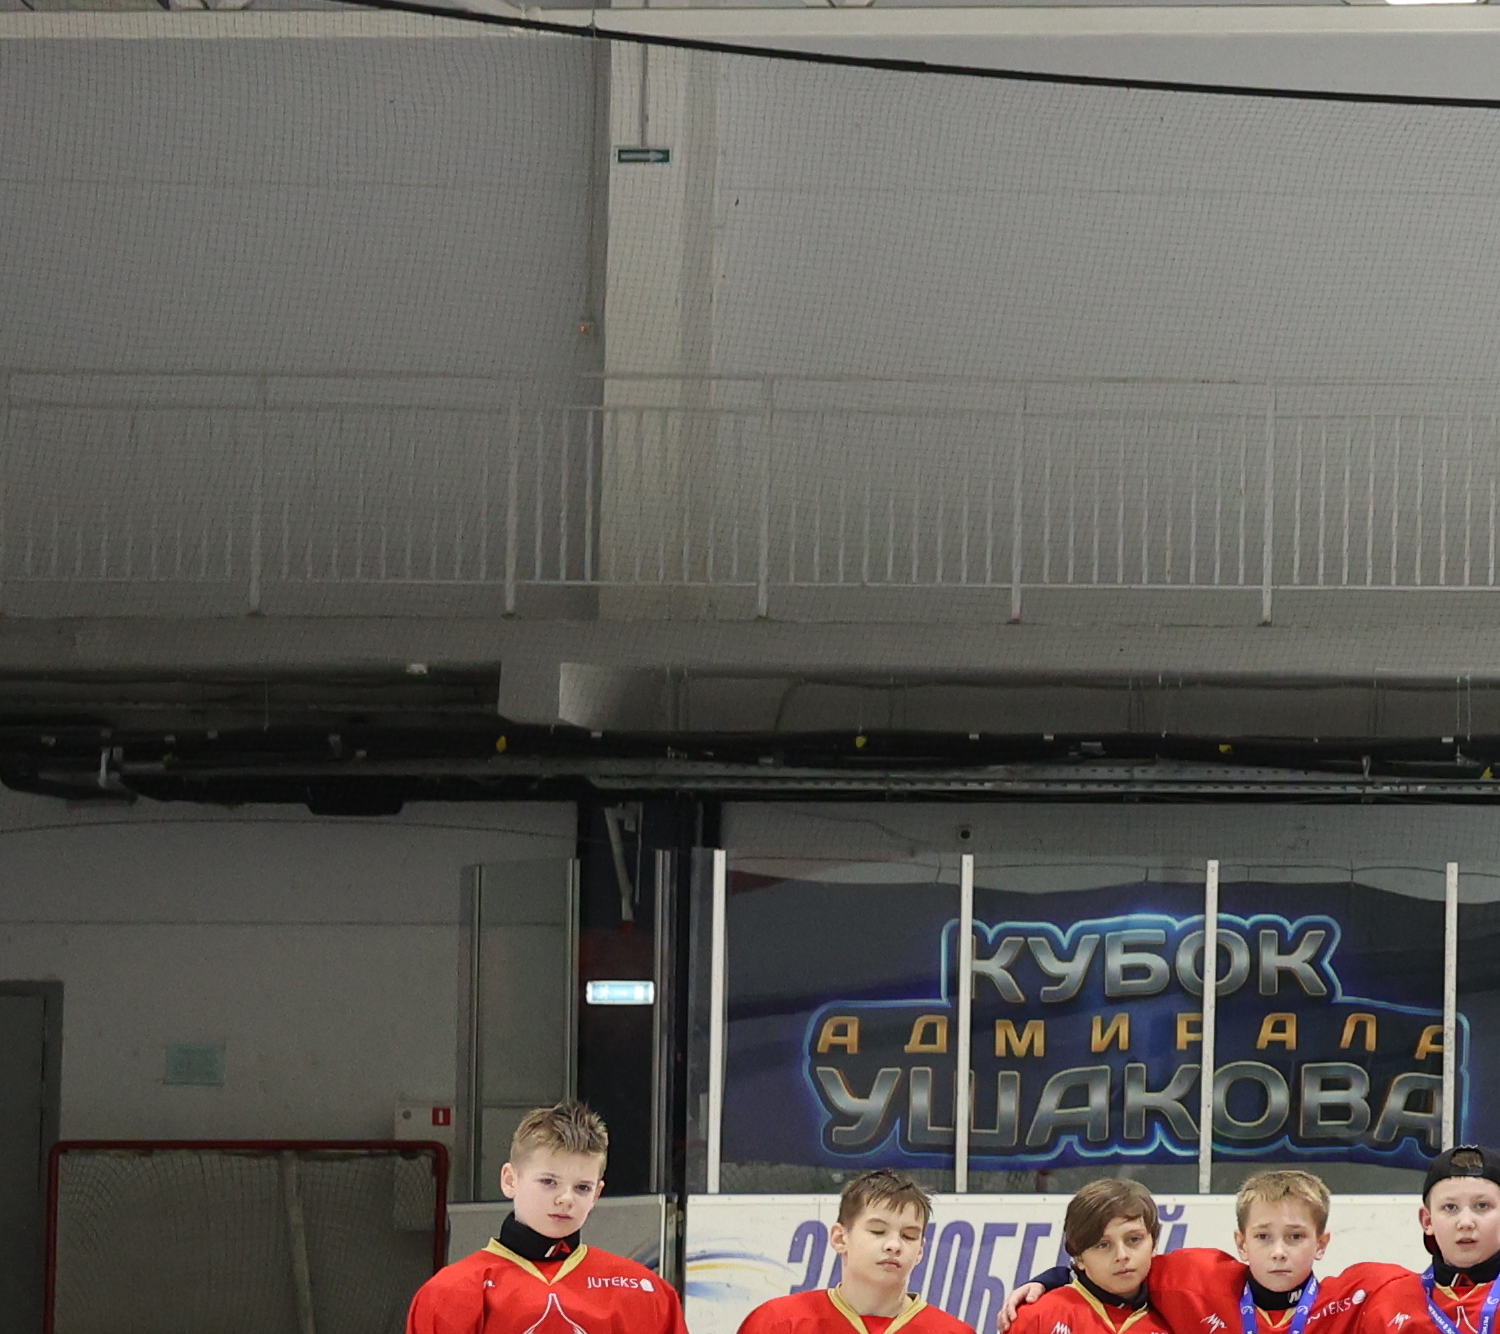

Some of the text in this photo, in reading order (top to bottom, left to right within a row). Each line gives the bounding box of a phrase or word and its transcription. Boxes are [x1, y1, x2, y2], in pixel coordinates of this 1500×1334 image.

[970, 929, 1327, 1003] КУБОК
[817, 1012, 1445, 1060] АДМИРАЛА
[816, 1061, 1445, 1147] УШАКОВА
[586, 1275, 640, 1292] JUTEKS
